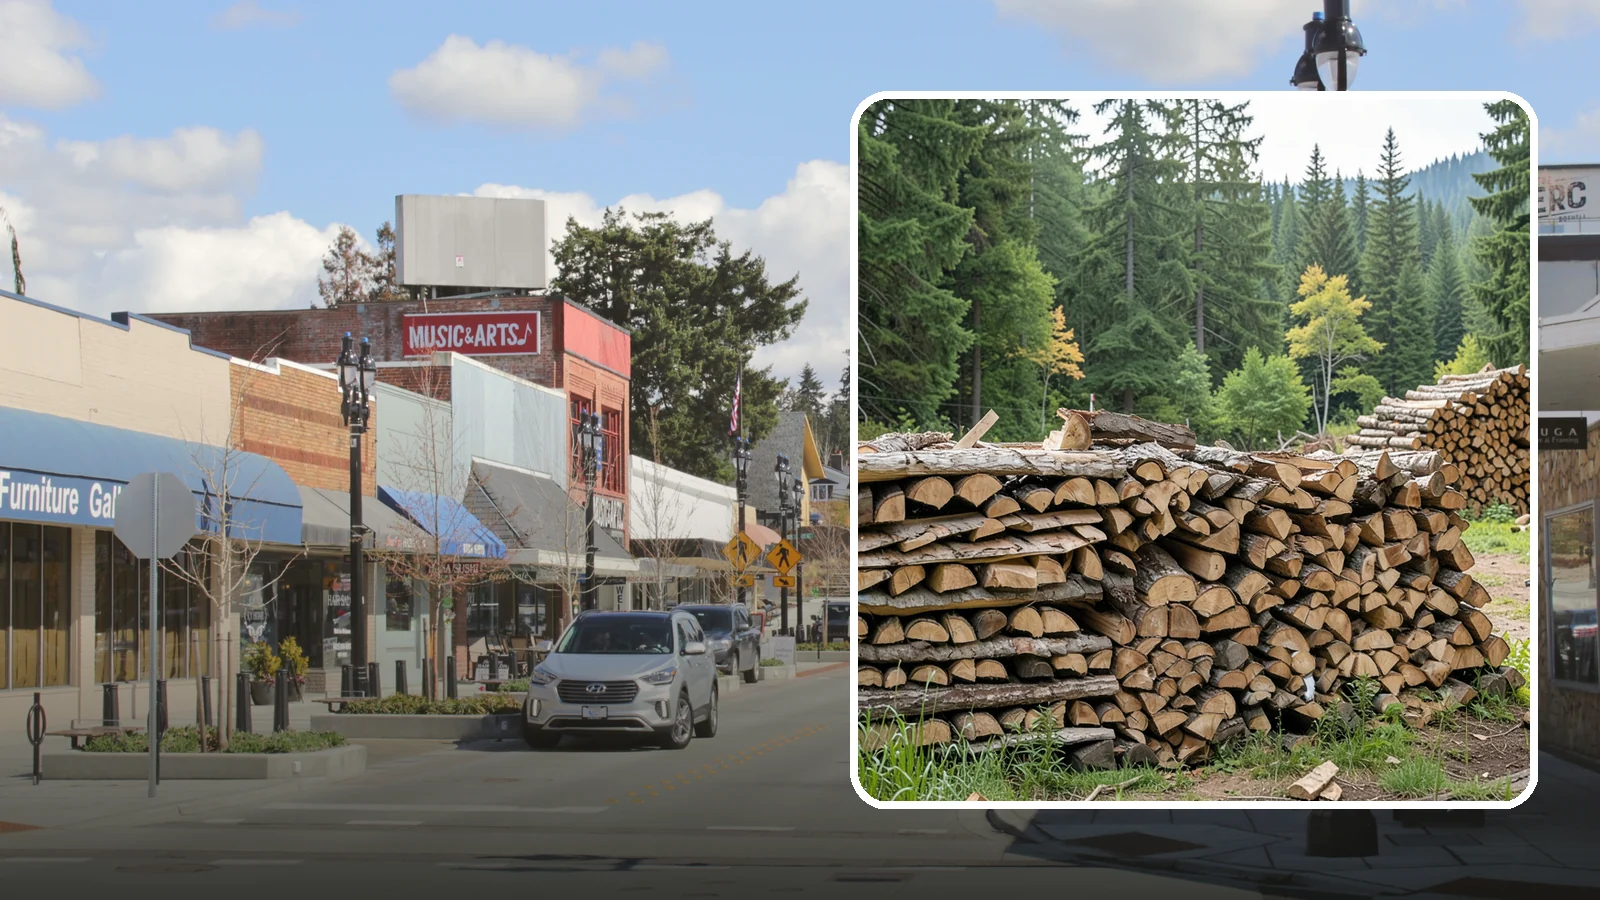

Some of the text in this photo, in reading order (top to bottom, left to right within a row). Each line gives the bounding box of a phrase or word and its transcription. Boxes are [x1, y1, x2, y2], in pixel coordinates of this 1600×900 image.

[1540, 428, 1577, 436] UGA
[0, 472, 79, 515] Furniture
[453, 563, 479, 574] SUSHI
